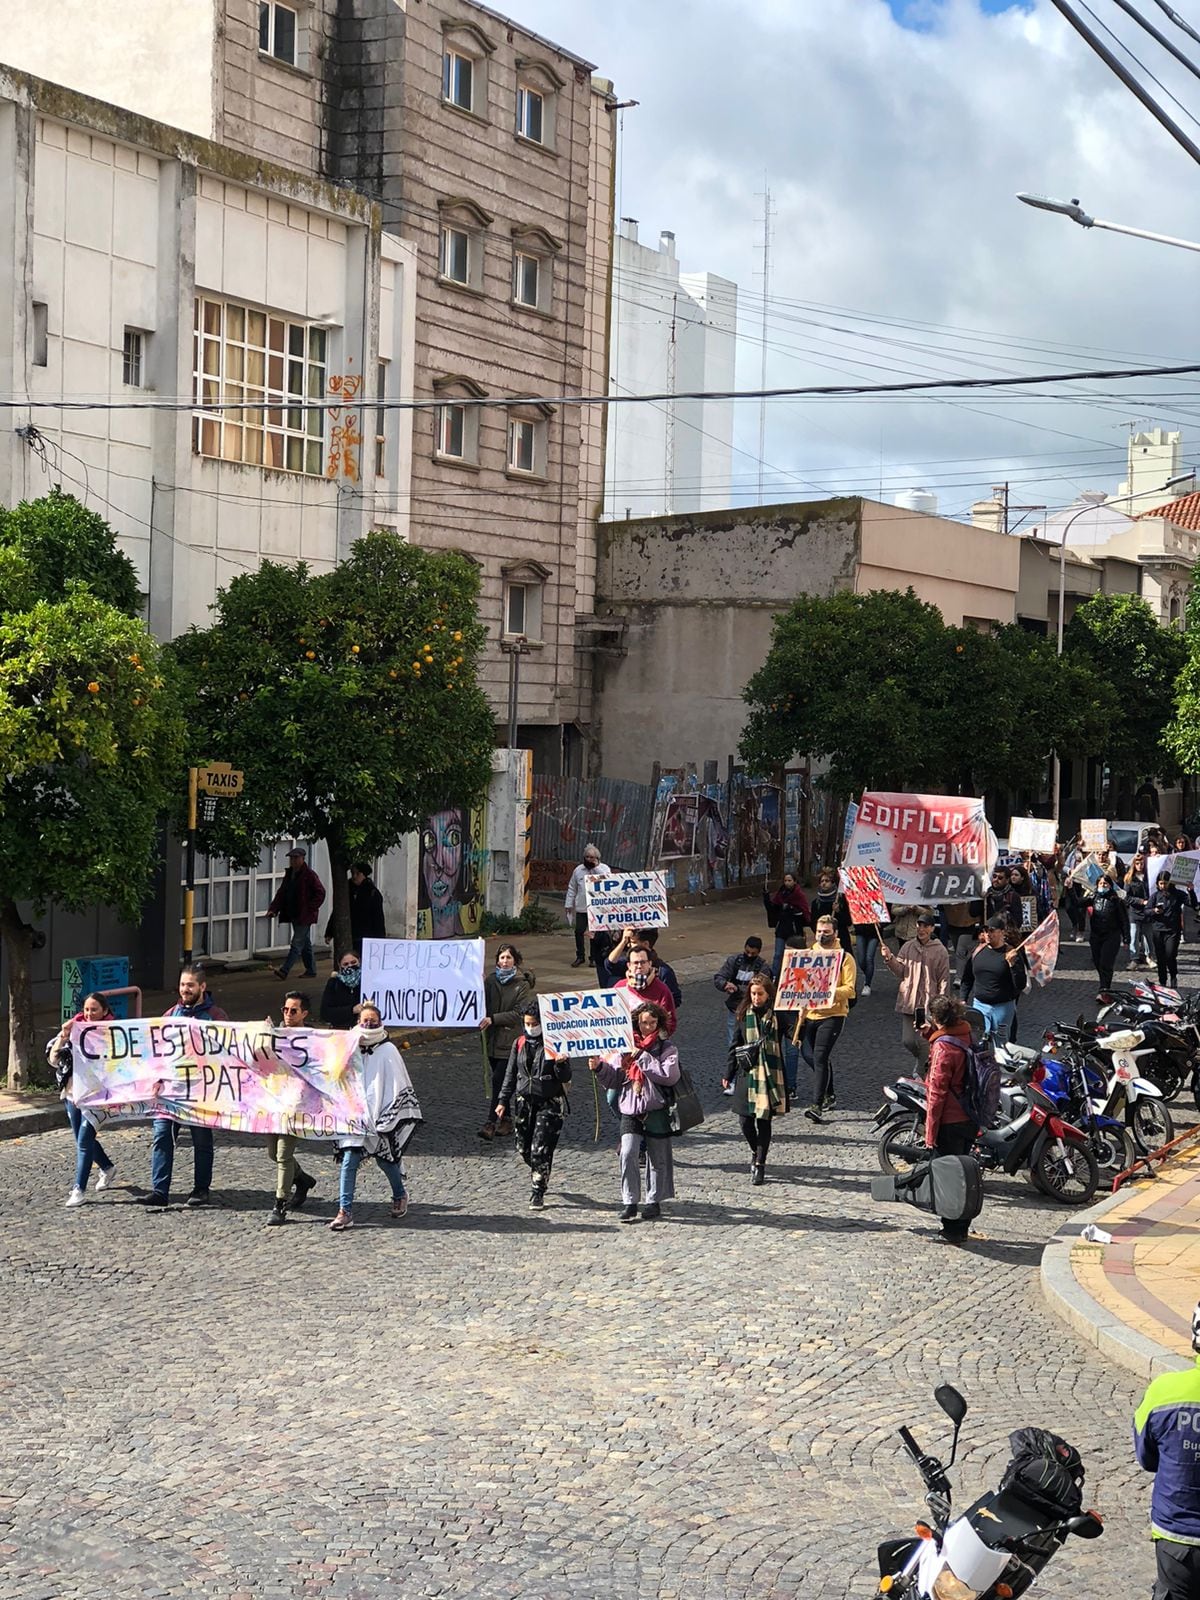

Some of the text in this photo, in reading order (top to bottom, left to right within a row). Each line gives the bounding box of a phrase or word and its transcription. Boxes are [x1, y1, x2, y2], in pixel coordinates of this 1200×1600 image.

[207, 773, 238, 787] TAXIS
[860, 801, 965, 835] EDIFICIO
[901, 842, 979, 865] DIGNO
[1000, 857, 1023, 866] IPA
[594, 879, 653, 892] IPAT
[591, 895, 662, 906] EDUCACION ARTISTICA
[596, 911, 661, 924] Y PUBLICA
[368, 942, 476, 970] RESPUESTA
[790, 955, 836, 968] IPAT
[551, 993, 617, 1012] IPAT
[781, 991, 811, 999] EDIFICIO
[546, 1016, 628, 1031] EDUCACION ARTISTICA
[150, 1024, 308, 1067] ESTUDIANTES
[553, 1037, 627, 1052] Y PUBLICA
[175, 1064, 247, 1102] IPAT
[1177, 1411, 1200, 1432] PO
